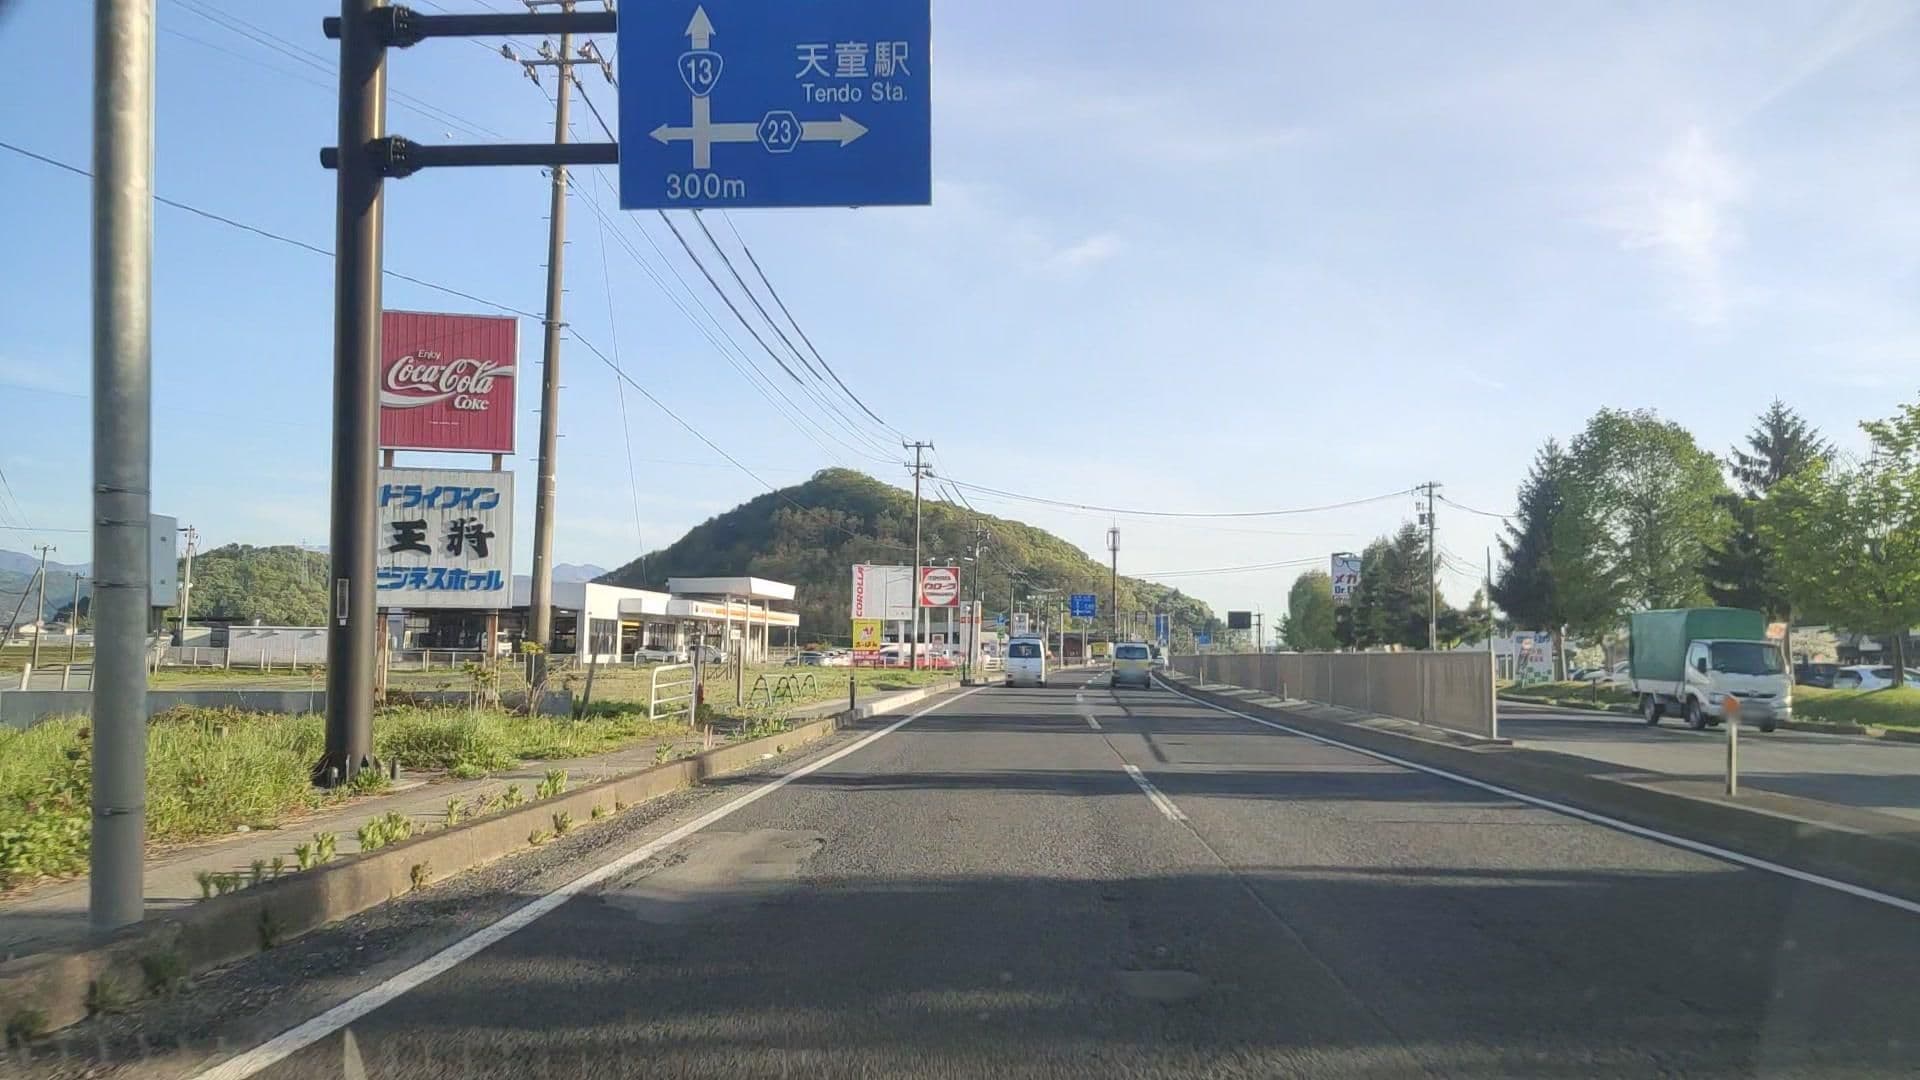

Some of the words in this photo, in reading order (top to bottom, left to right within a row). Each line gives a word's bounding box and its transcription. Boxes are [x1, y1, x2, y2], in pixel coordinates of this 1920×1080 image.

[687, 57, 713, 85] 13
[795, 41, 911, 79] 天童駅
[802, 84, 862, 103] Tendo
[871, 82, 908, 102] Sta.
[767, 119, 792, 144] 23
[666, 173, 746, 199] 300m
[418, 350, 441, 360] Enjoy
[387, 355, 499, 394] Coca-Cola
[454, 394, 490, 410] Coke
[855, 565, 864, 618] COROLLA
